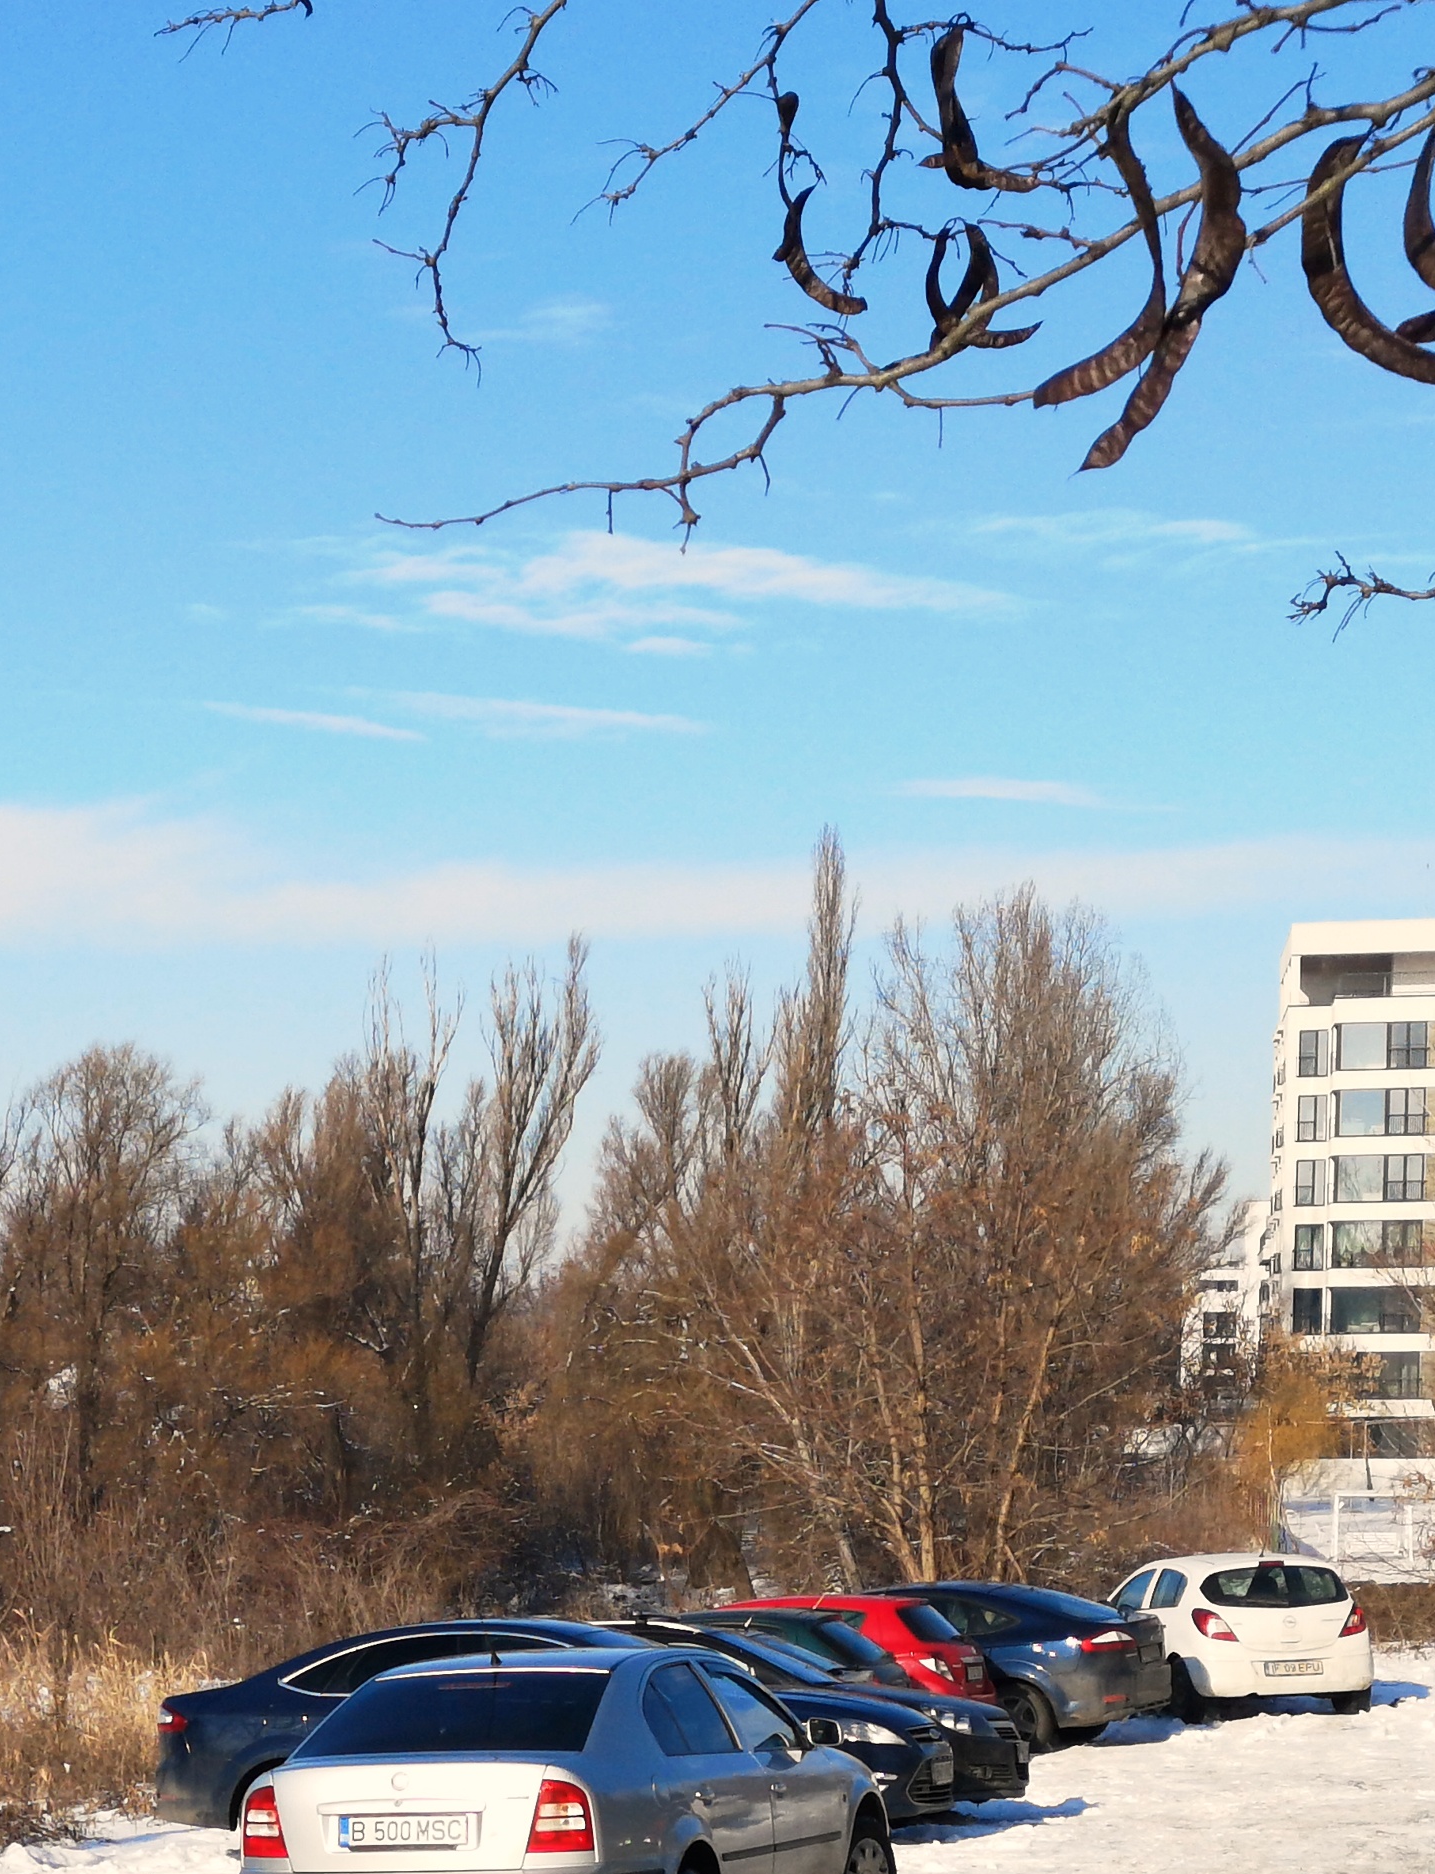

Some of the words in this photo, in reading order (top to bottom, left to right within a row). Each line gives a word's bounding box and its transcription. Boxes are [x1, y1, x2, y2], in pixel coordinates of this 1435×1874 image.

[351, 1821, 365, 1842] B
[374, 1820, 411, 1842] 500
[416, 1819, 462, 1842] MSC
